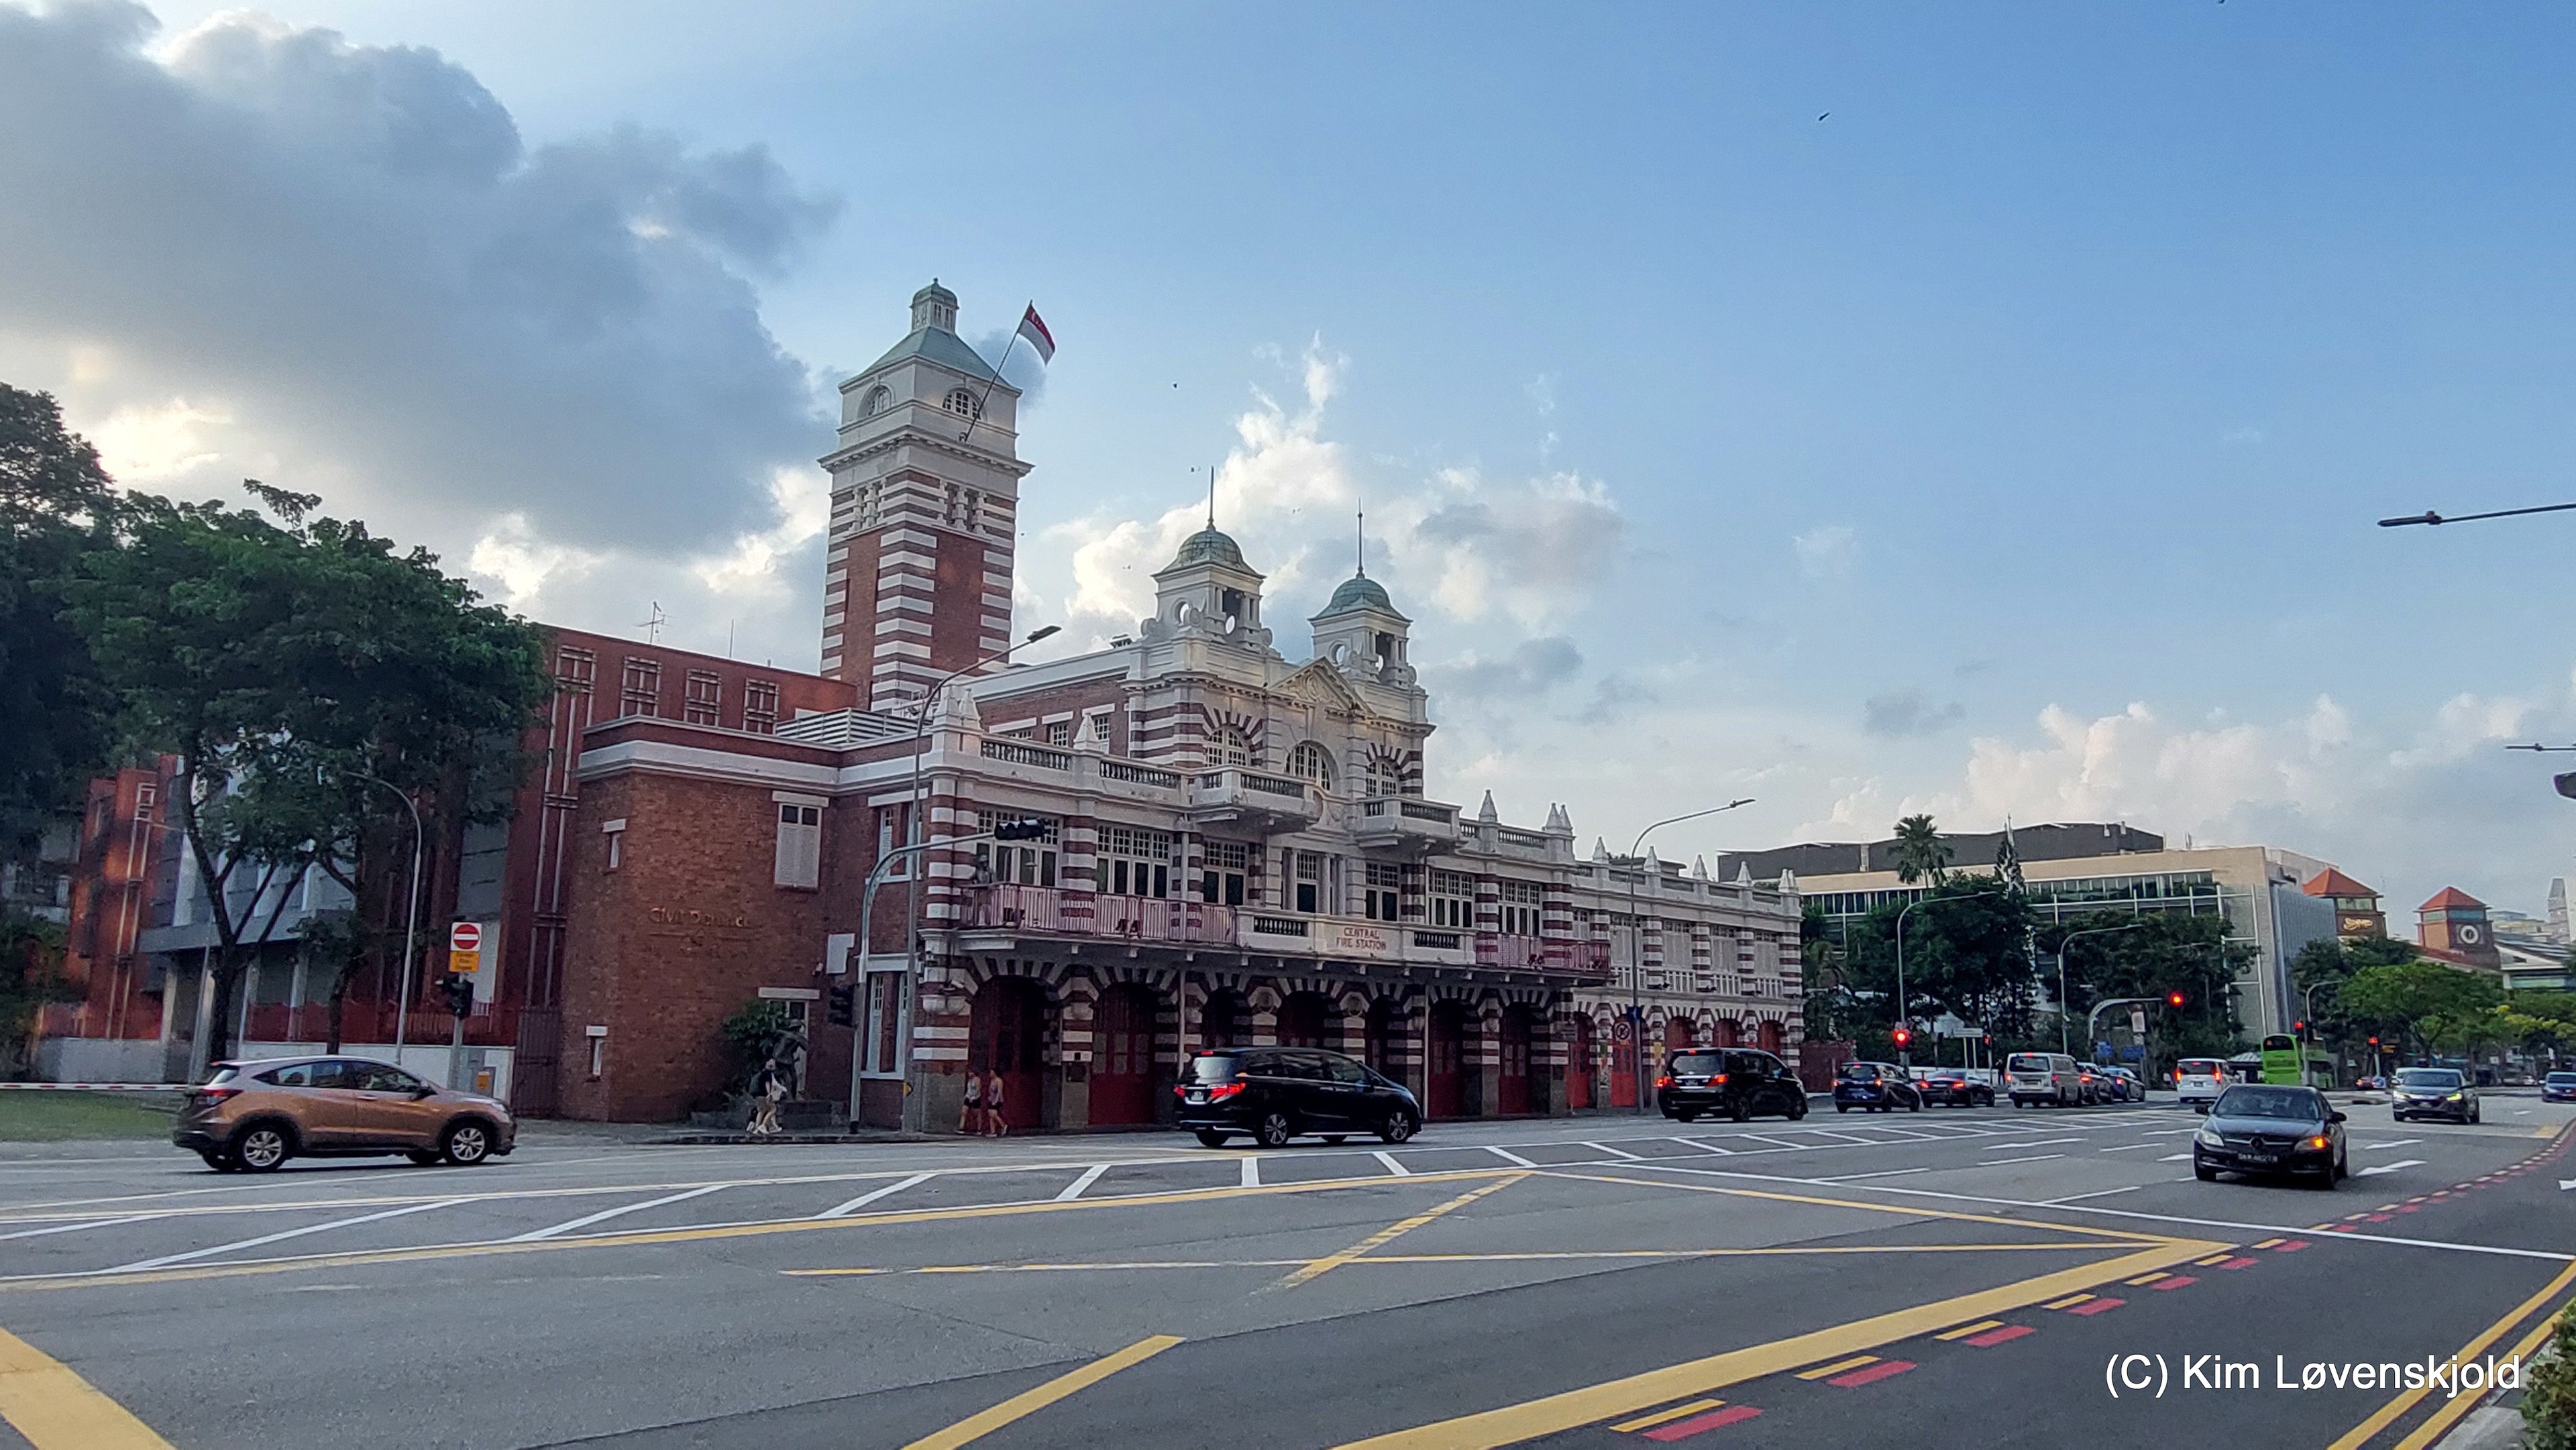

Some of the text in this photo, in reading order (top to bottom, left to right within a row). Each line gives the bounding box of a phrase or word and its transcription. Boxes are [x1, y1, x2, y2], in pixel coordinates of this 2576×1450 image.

[1344, 927, 1380, 940] CENTRAL
[1336, 937, 1387, 950] FIRE STATION
